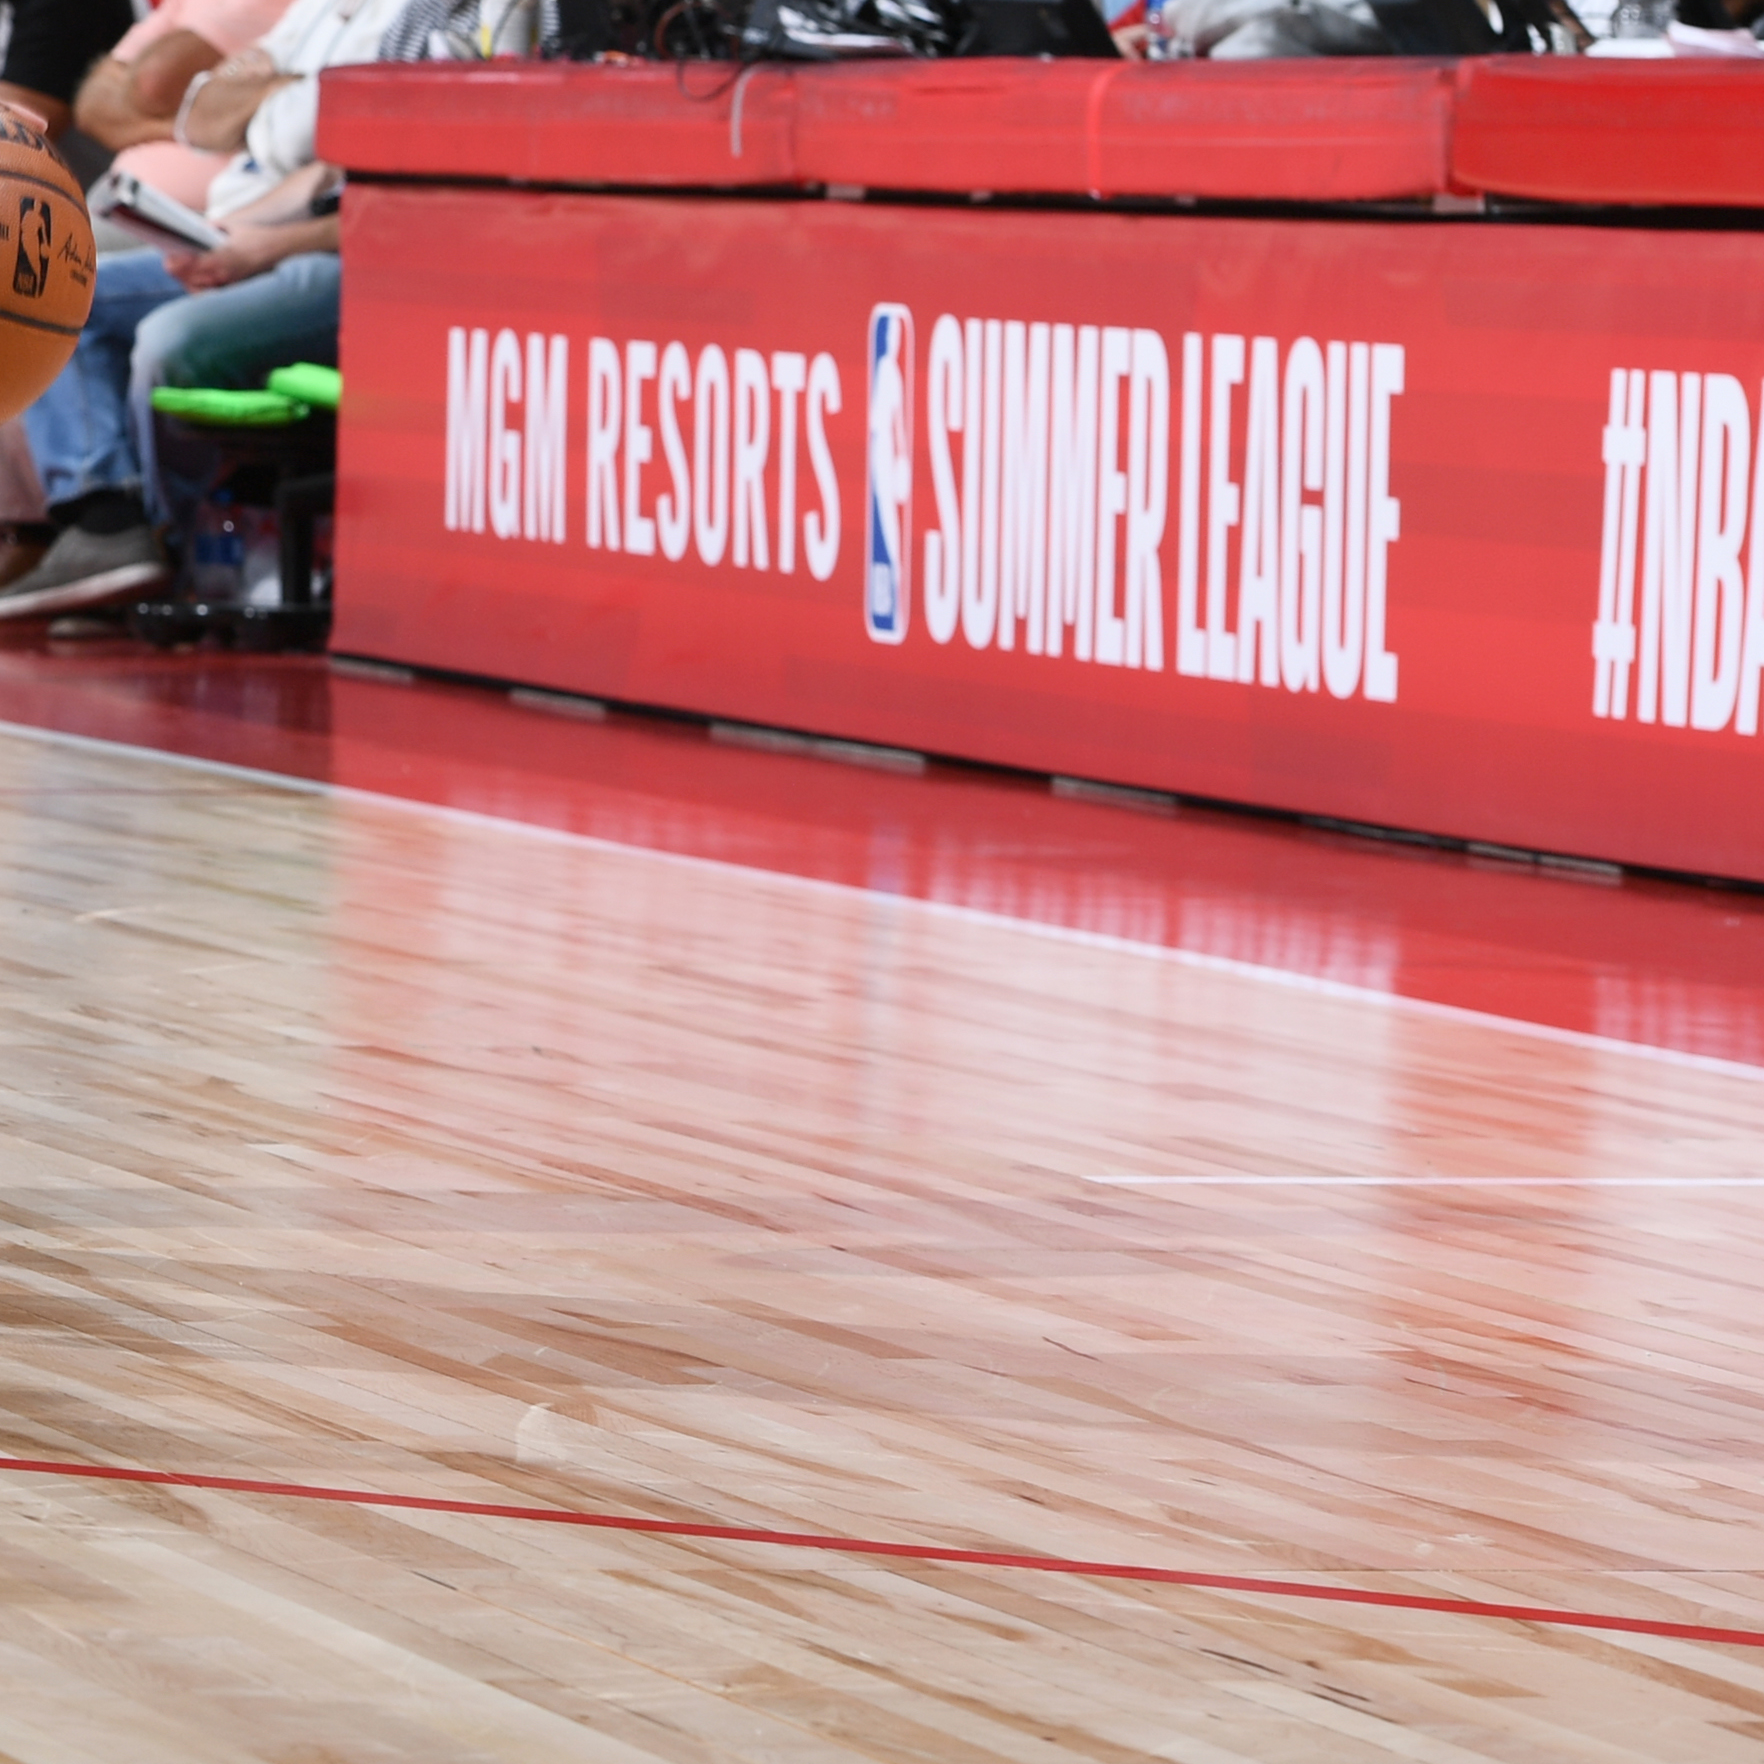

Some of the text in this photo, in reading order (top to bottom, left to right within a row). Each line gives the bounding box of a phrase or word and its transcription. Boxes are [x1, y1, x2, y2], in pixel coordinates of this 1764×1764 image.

[444, 325, 569, 545] MGM
[585, 336, 843, 582] RESORTS
[924, 313, 1171, 673] SUMMER
[1176, 330, 1406, 705] LEAGUE
